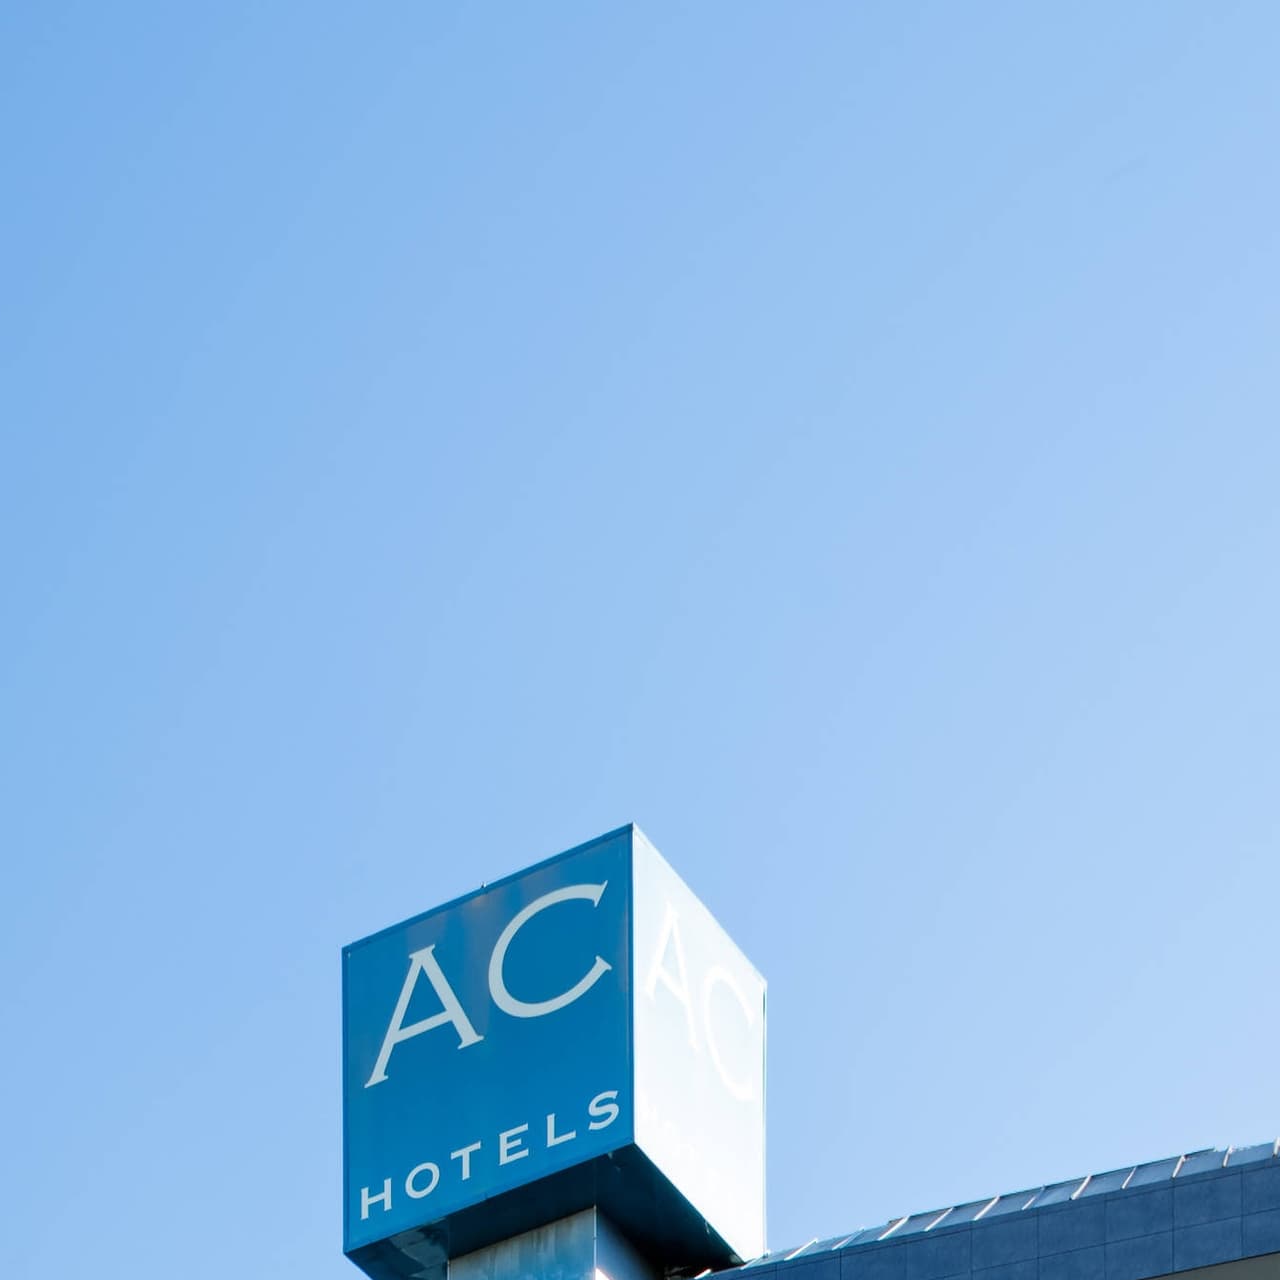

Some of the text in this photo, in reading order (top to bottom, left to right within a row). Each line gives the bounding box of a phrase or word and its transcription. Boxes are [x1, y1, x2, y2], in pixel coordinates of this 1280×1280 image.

[364, 880, 612, 1088] AC
[645, 899, 756, 1103] AC
[360, 1090, 620, 1220] HOTELS
